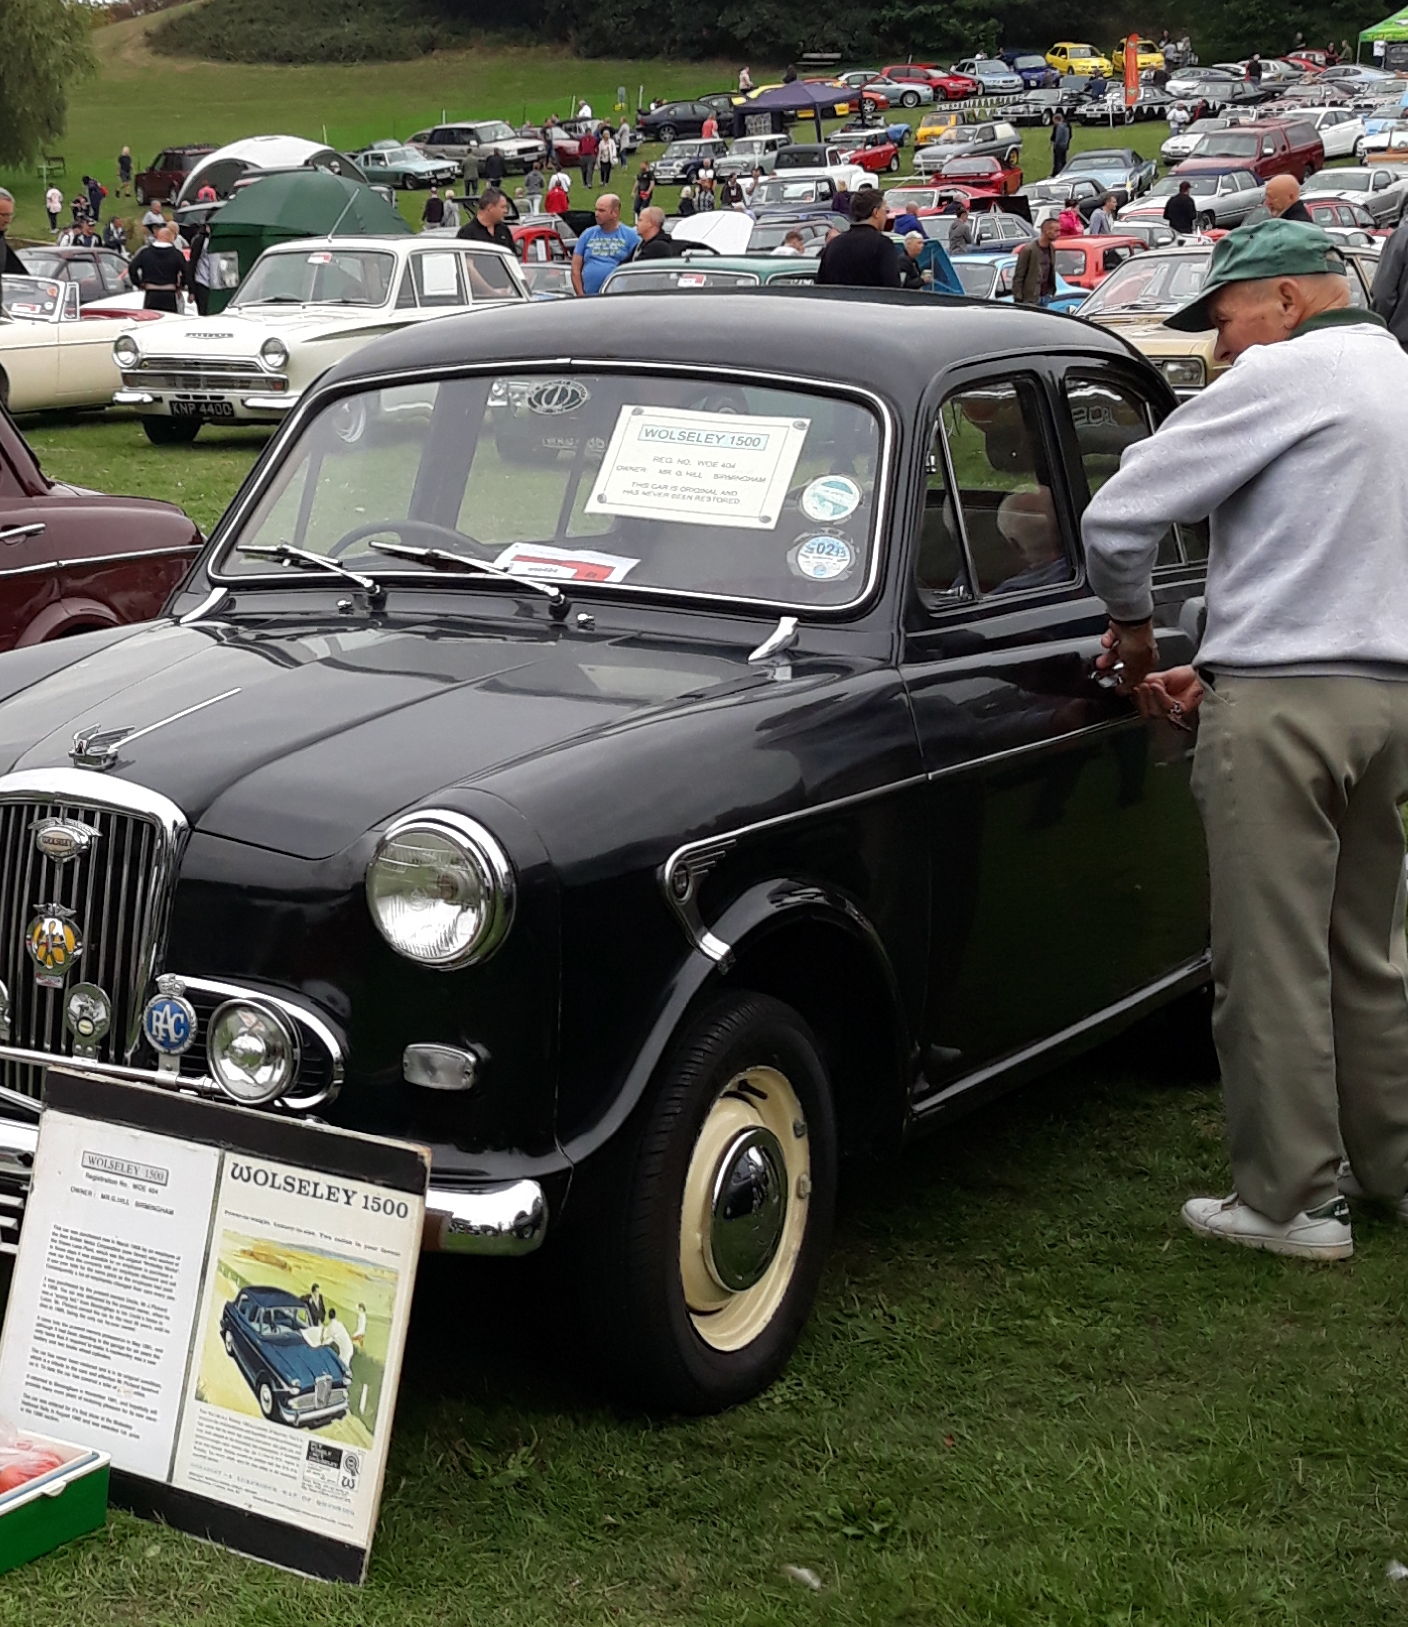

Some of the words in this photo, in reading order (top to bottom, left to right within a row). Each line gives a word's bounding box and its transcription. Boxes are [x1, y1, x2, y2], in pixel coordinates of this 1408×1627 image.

[172, 402, 196, 415] KNP
[644, 428, 726, 445] WOLSELEY
[729, 436, 761, 448] 1500
[632, 481, 650, 490] THIS
[651, 482, 668, 491] CAR
[670, 484, 678, 492] IS
[680, 484, 718, 496] ORIGINAL
[721, 489, 738, 497] AND
[641, 490, 670, 499] NEVER
[671, 492, 693, 502] BEEN
[694, 494, 741, 505] RESTORED
[816, 542, 834, 555] 02
[151, 1003, 185, 1044] RAC
[87, 1155, 141, 1176] WOLSELEY
[144, 1168, 164, 1181] 1500
[85, 1171, 118, 1187] Registration
[132, 1183, 147, 1193] WOE
[230, 1162, 358, 1207] WOLSELEY
[361, 1194, 409, 1219] 1500
